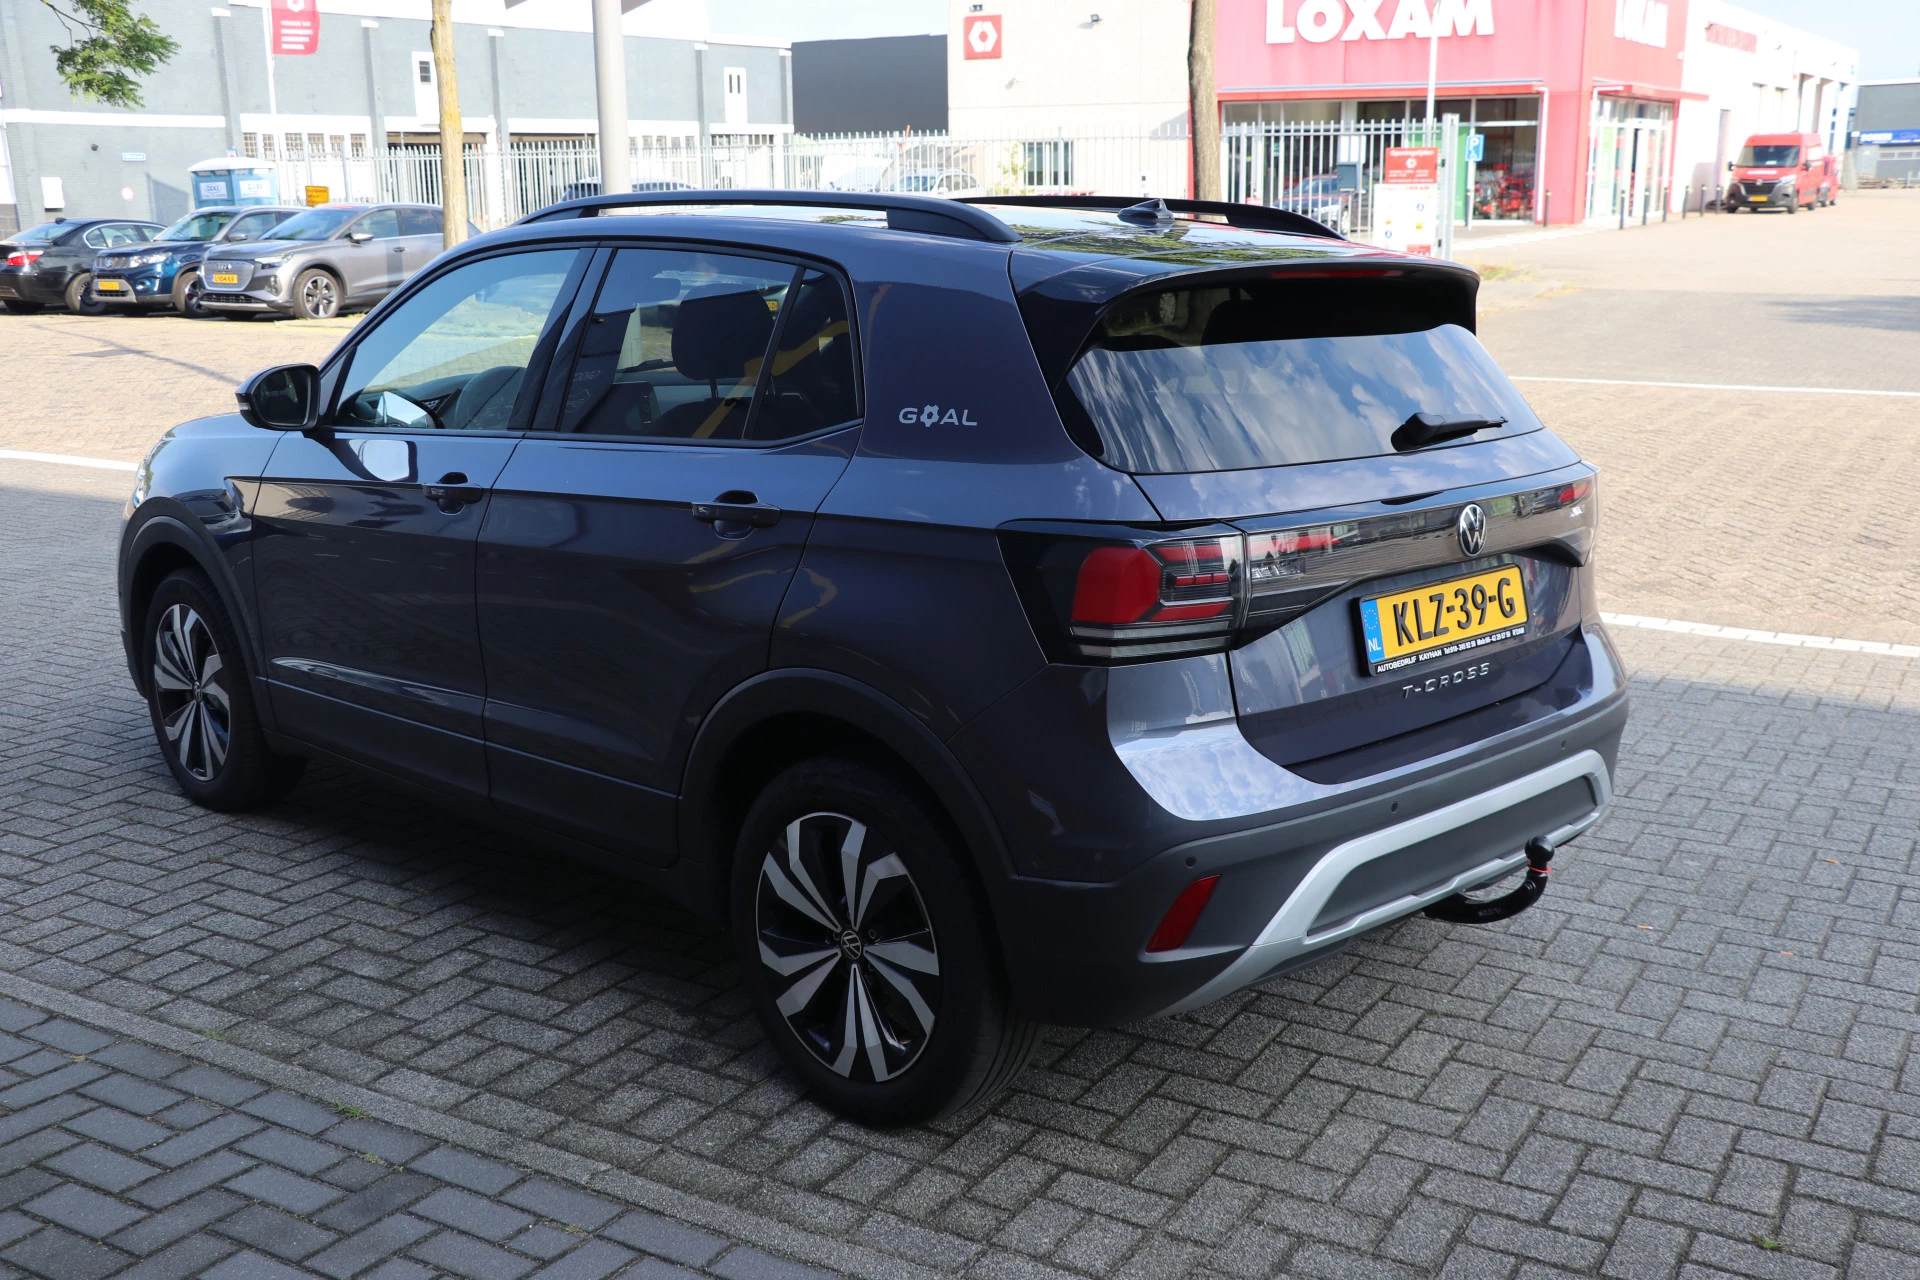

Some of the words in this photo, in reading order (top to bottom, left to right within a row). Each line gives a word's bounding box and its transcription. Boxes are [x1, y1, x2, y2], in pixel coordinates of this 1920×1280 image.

[1265, 0, 1495, 44] LOXAM
[899, 404, 978, 428] GOAL
[1393, 577, 1516, 647] KLZ-39-G
[1368, 637, 1381, 653] NL
[1377, 655, 1417, 673] AUTOBEDRIJF
[1419, 647, 1442, 662] KAYHAN
[1402, 662, 1490, 700] T-CROSS
